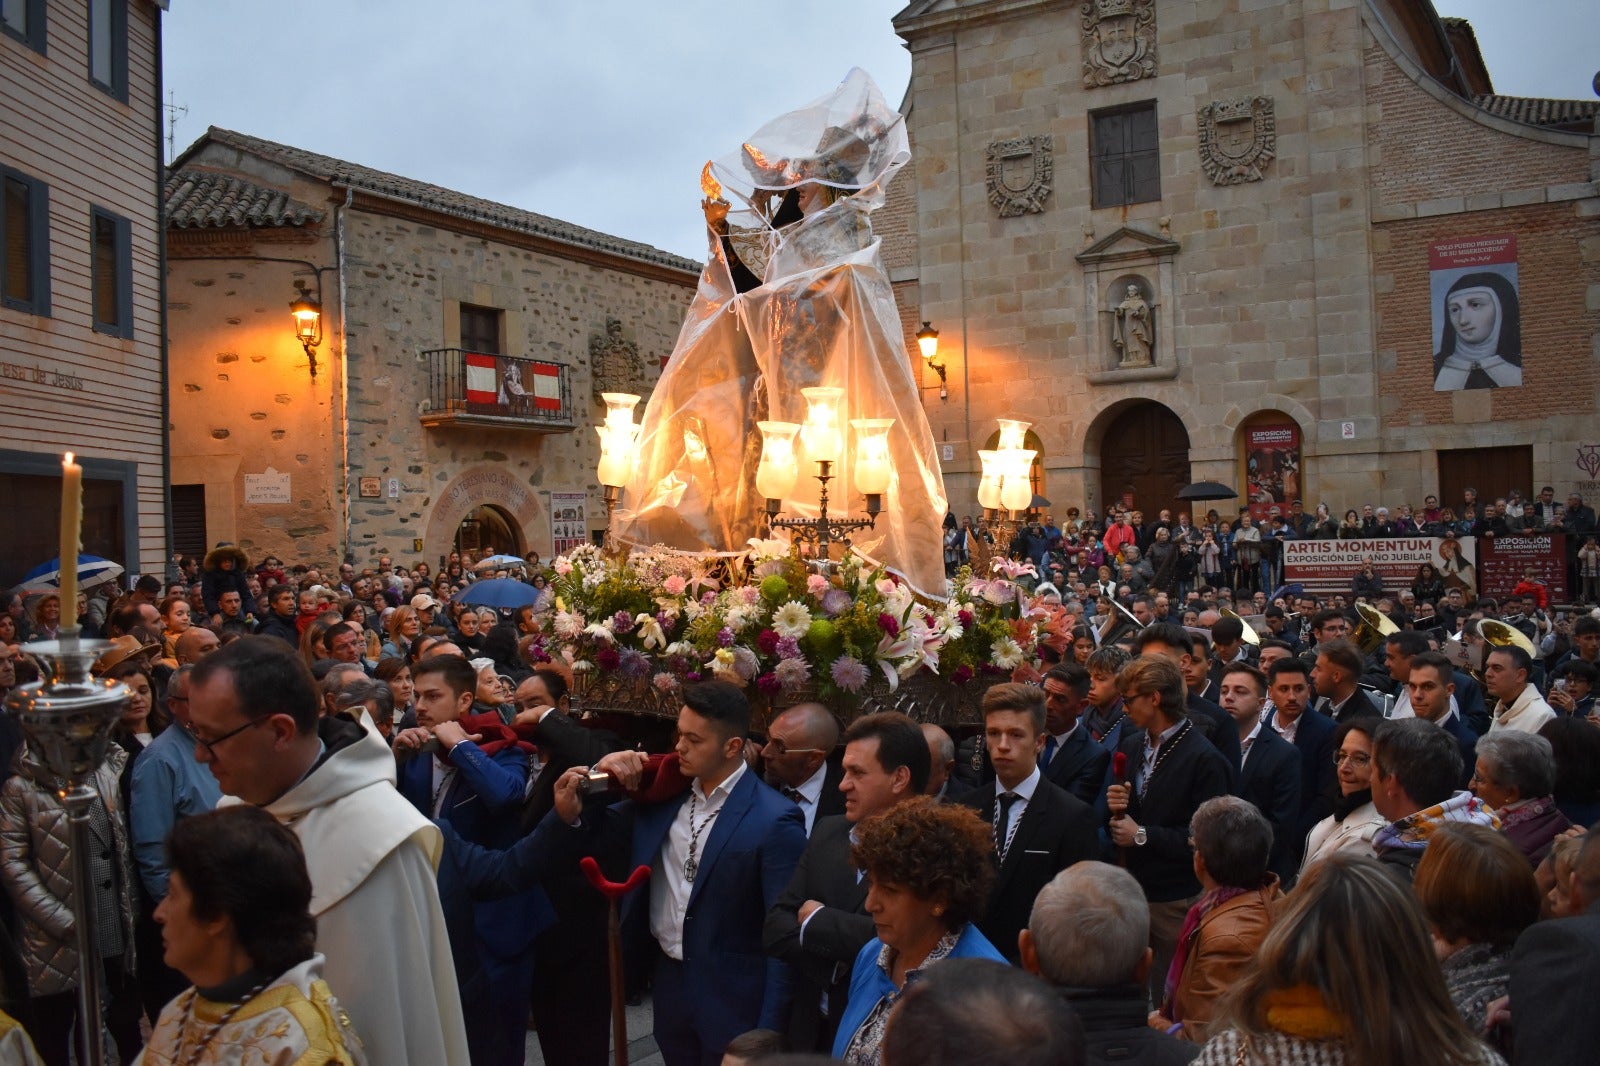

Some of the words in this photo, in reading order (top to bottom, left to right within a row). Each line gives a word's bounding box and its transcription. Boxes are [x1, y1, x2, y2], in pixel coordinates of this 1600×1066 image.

[1454, 242, 1476, 250] PUEDO
[1476, 238, 1509, 247] PRESUMIR
[32, 364, 46, 384] de
[1252, 429, 1292, 437] EXPOSICIÓN
[1493, 536, 1551, 545] EXPOSICIÓN
[1287, 542, 1331, 554] ARTIS
[1336, 539, 1432, 552] MOMENTUM
[1287, 554, 1344, 563] EXPOSICIÓN
[1347, 554, 1364, 562] DEL
[1369, 552, 1389, 562] AÑO
[1391, 552, 1432, 561] JUBILAR
